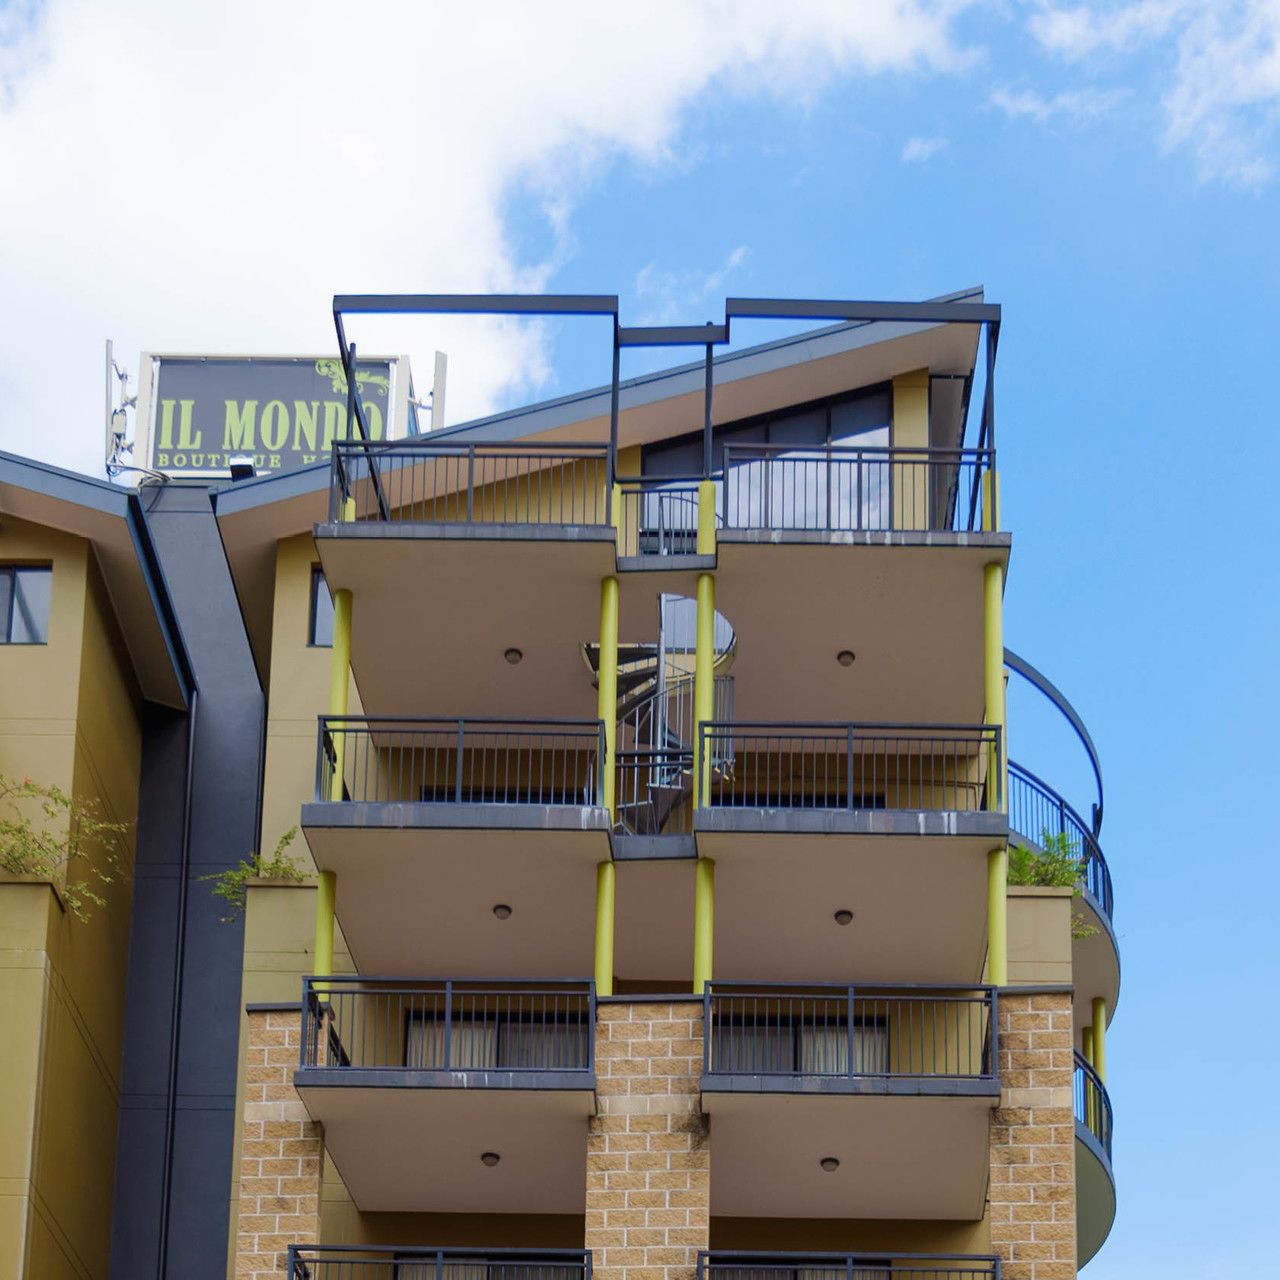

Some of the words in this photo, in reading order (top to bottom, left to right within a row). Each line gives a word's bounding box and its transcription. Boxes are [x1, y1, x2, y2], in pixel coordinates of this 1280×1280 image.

[158, 400, 202, 450] IL
[222, 399, 383, 451] MONDO
[157, 453, 282, 468] BOUTIUE
